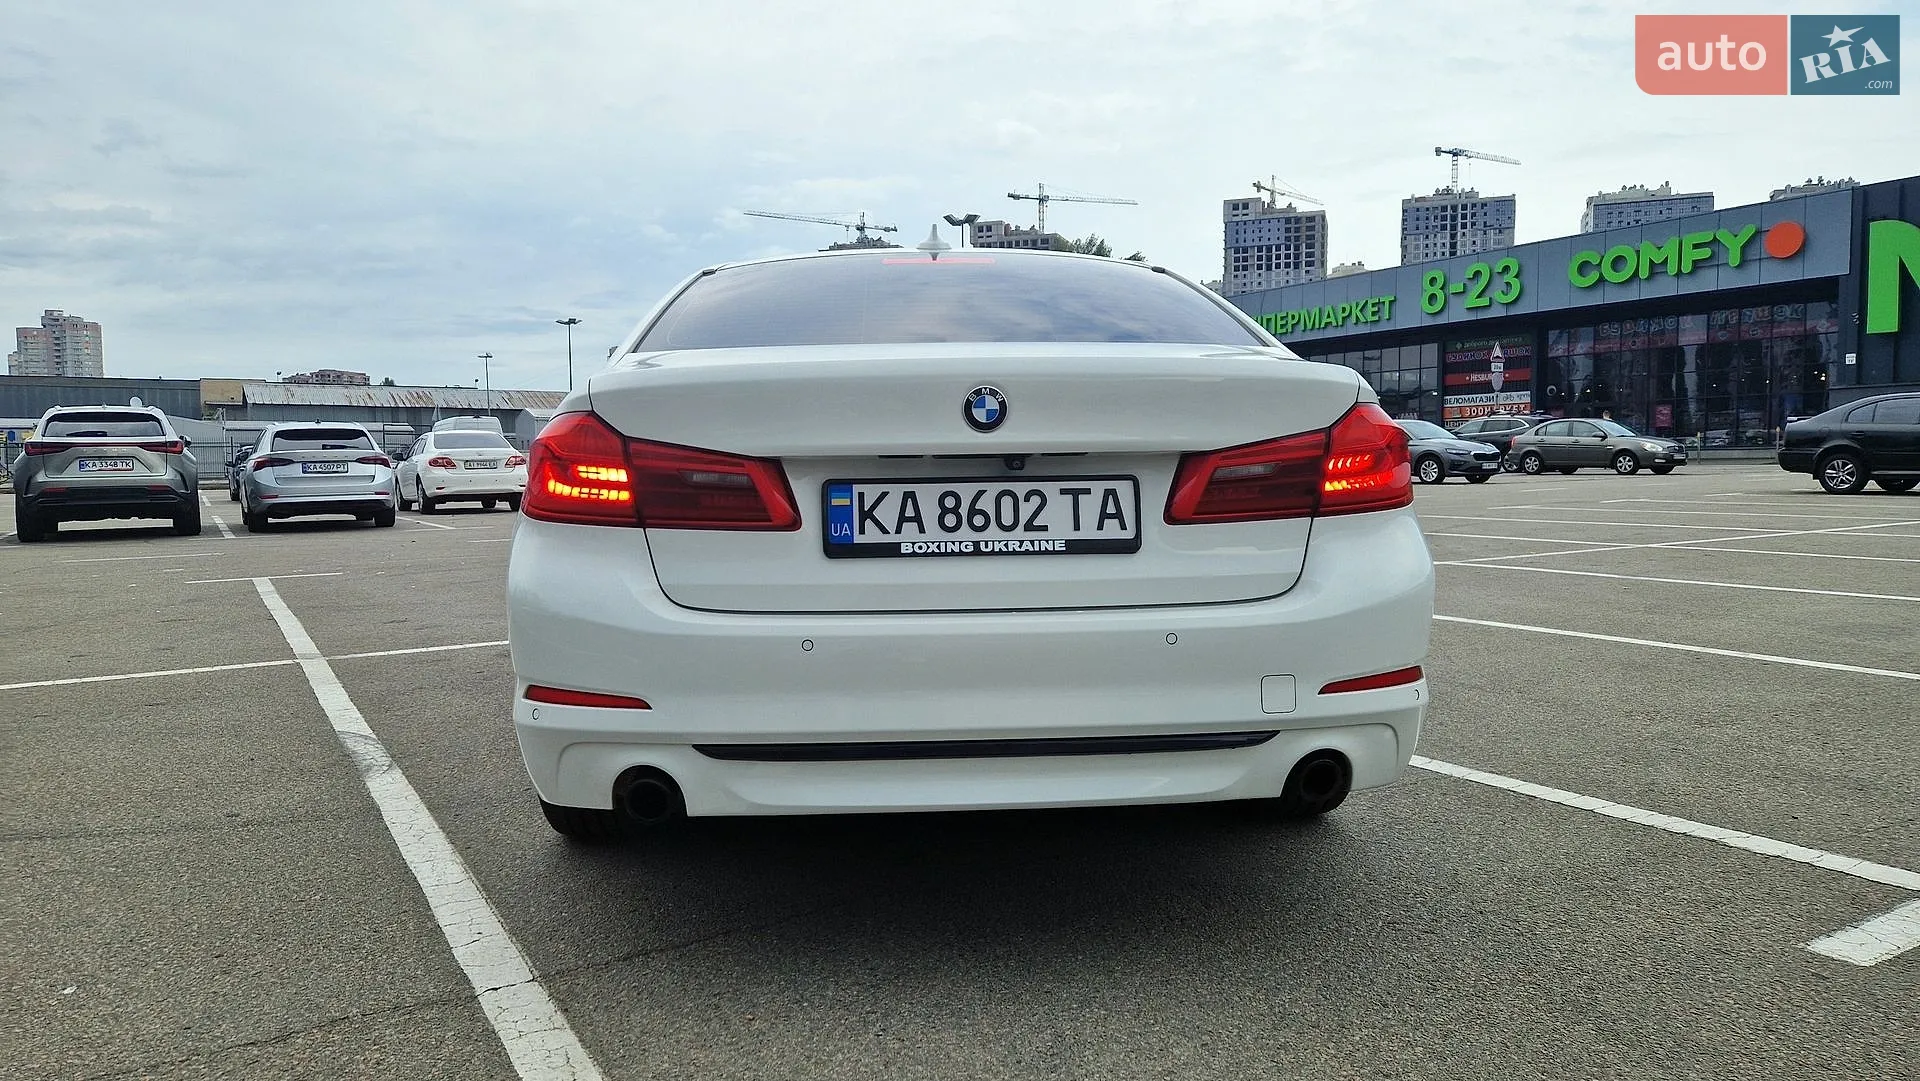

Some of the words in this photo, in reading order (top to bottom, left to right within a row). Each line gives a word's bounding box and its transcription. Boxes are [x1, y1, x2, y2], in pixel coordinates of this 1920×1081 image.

[1569, 223, 1758, 288] COMFY
[1421, 256, 1521, 314] 8-23
[1254, 295, 1396, 335] ПЕРМАРКЕТ
[969, 388, 1004, 402] BMW
[1445, 394, 1499, 406] ВЕЛОМАГАЗИ
[857, 491, 926, 535] KA
[937, 489, 1049, 533] 8602
[1059, 488, 1128, 532] TA
[831, 523, 851, 536] UA
[900, 540, 974, 554] BOXING
[980, 539, 1066, 552] UKRAINE
